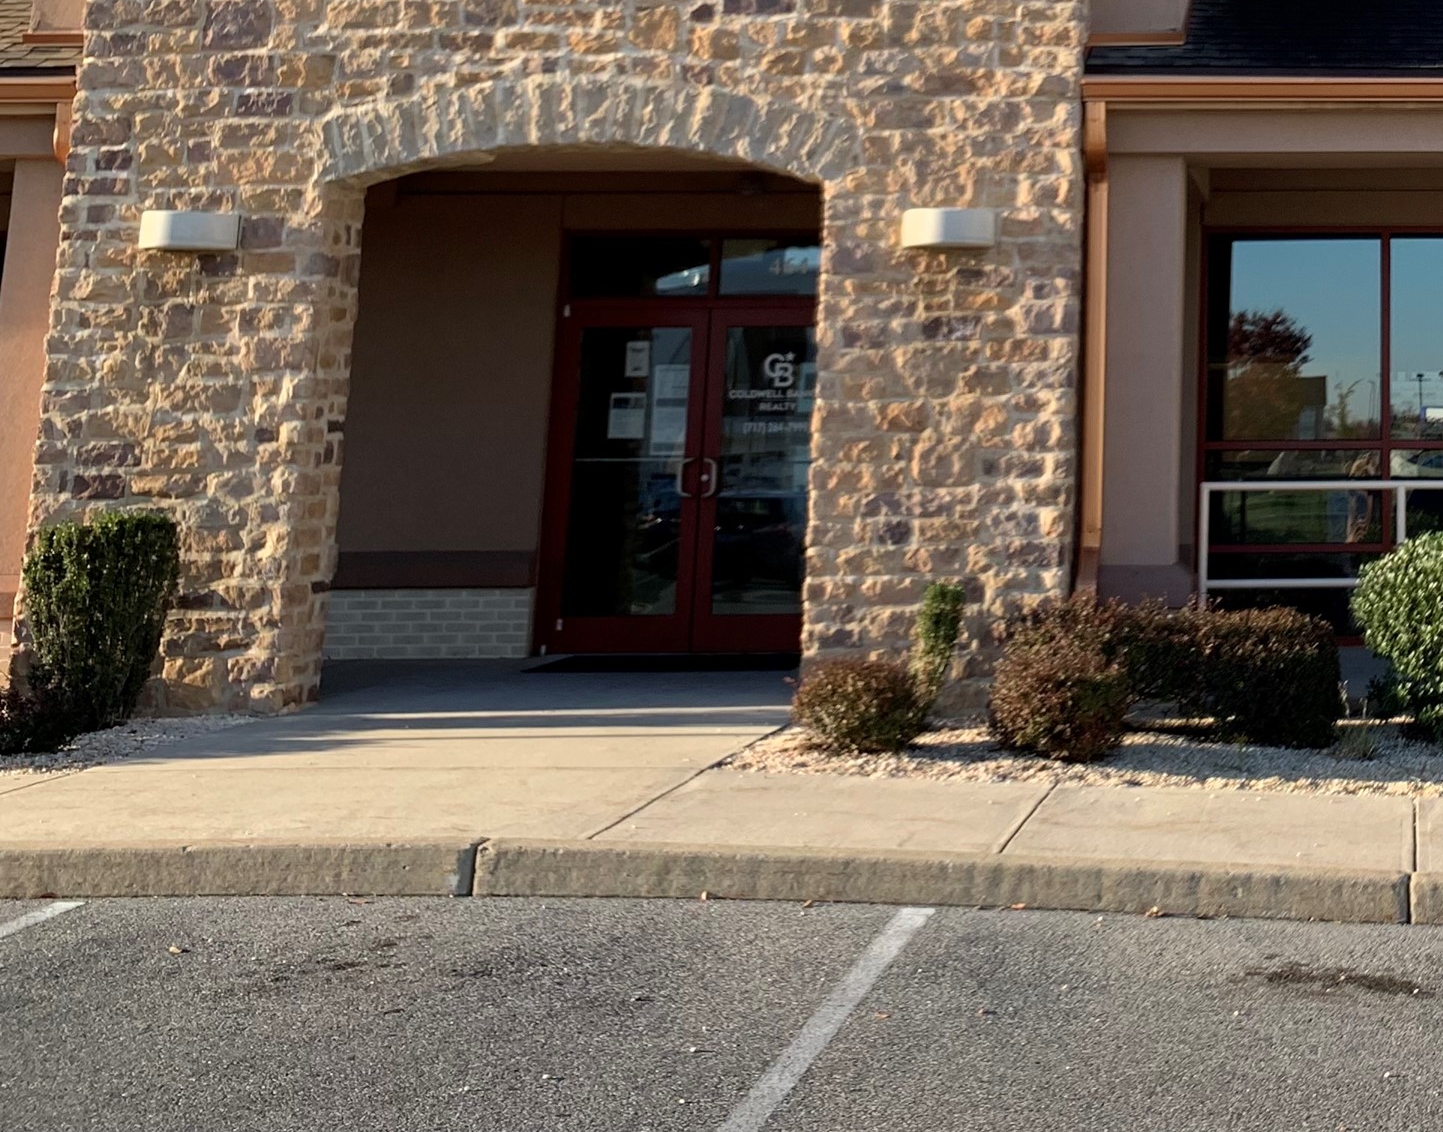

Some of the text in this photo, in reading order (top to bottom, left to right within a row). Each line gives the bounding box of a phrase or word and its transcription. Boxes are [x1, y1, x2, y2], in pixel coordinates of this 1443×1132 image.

[764, 353, 794, 387] CB
[728, 389, 784, 399] COLDWELL
[759, 402, 797, 411] REALTY
